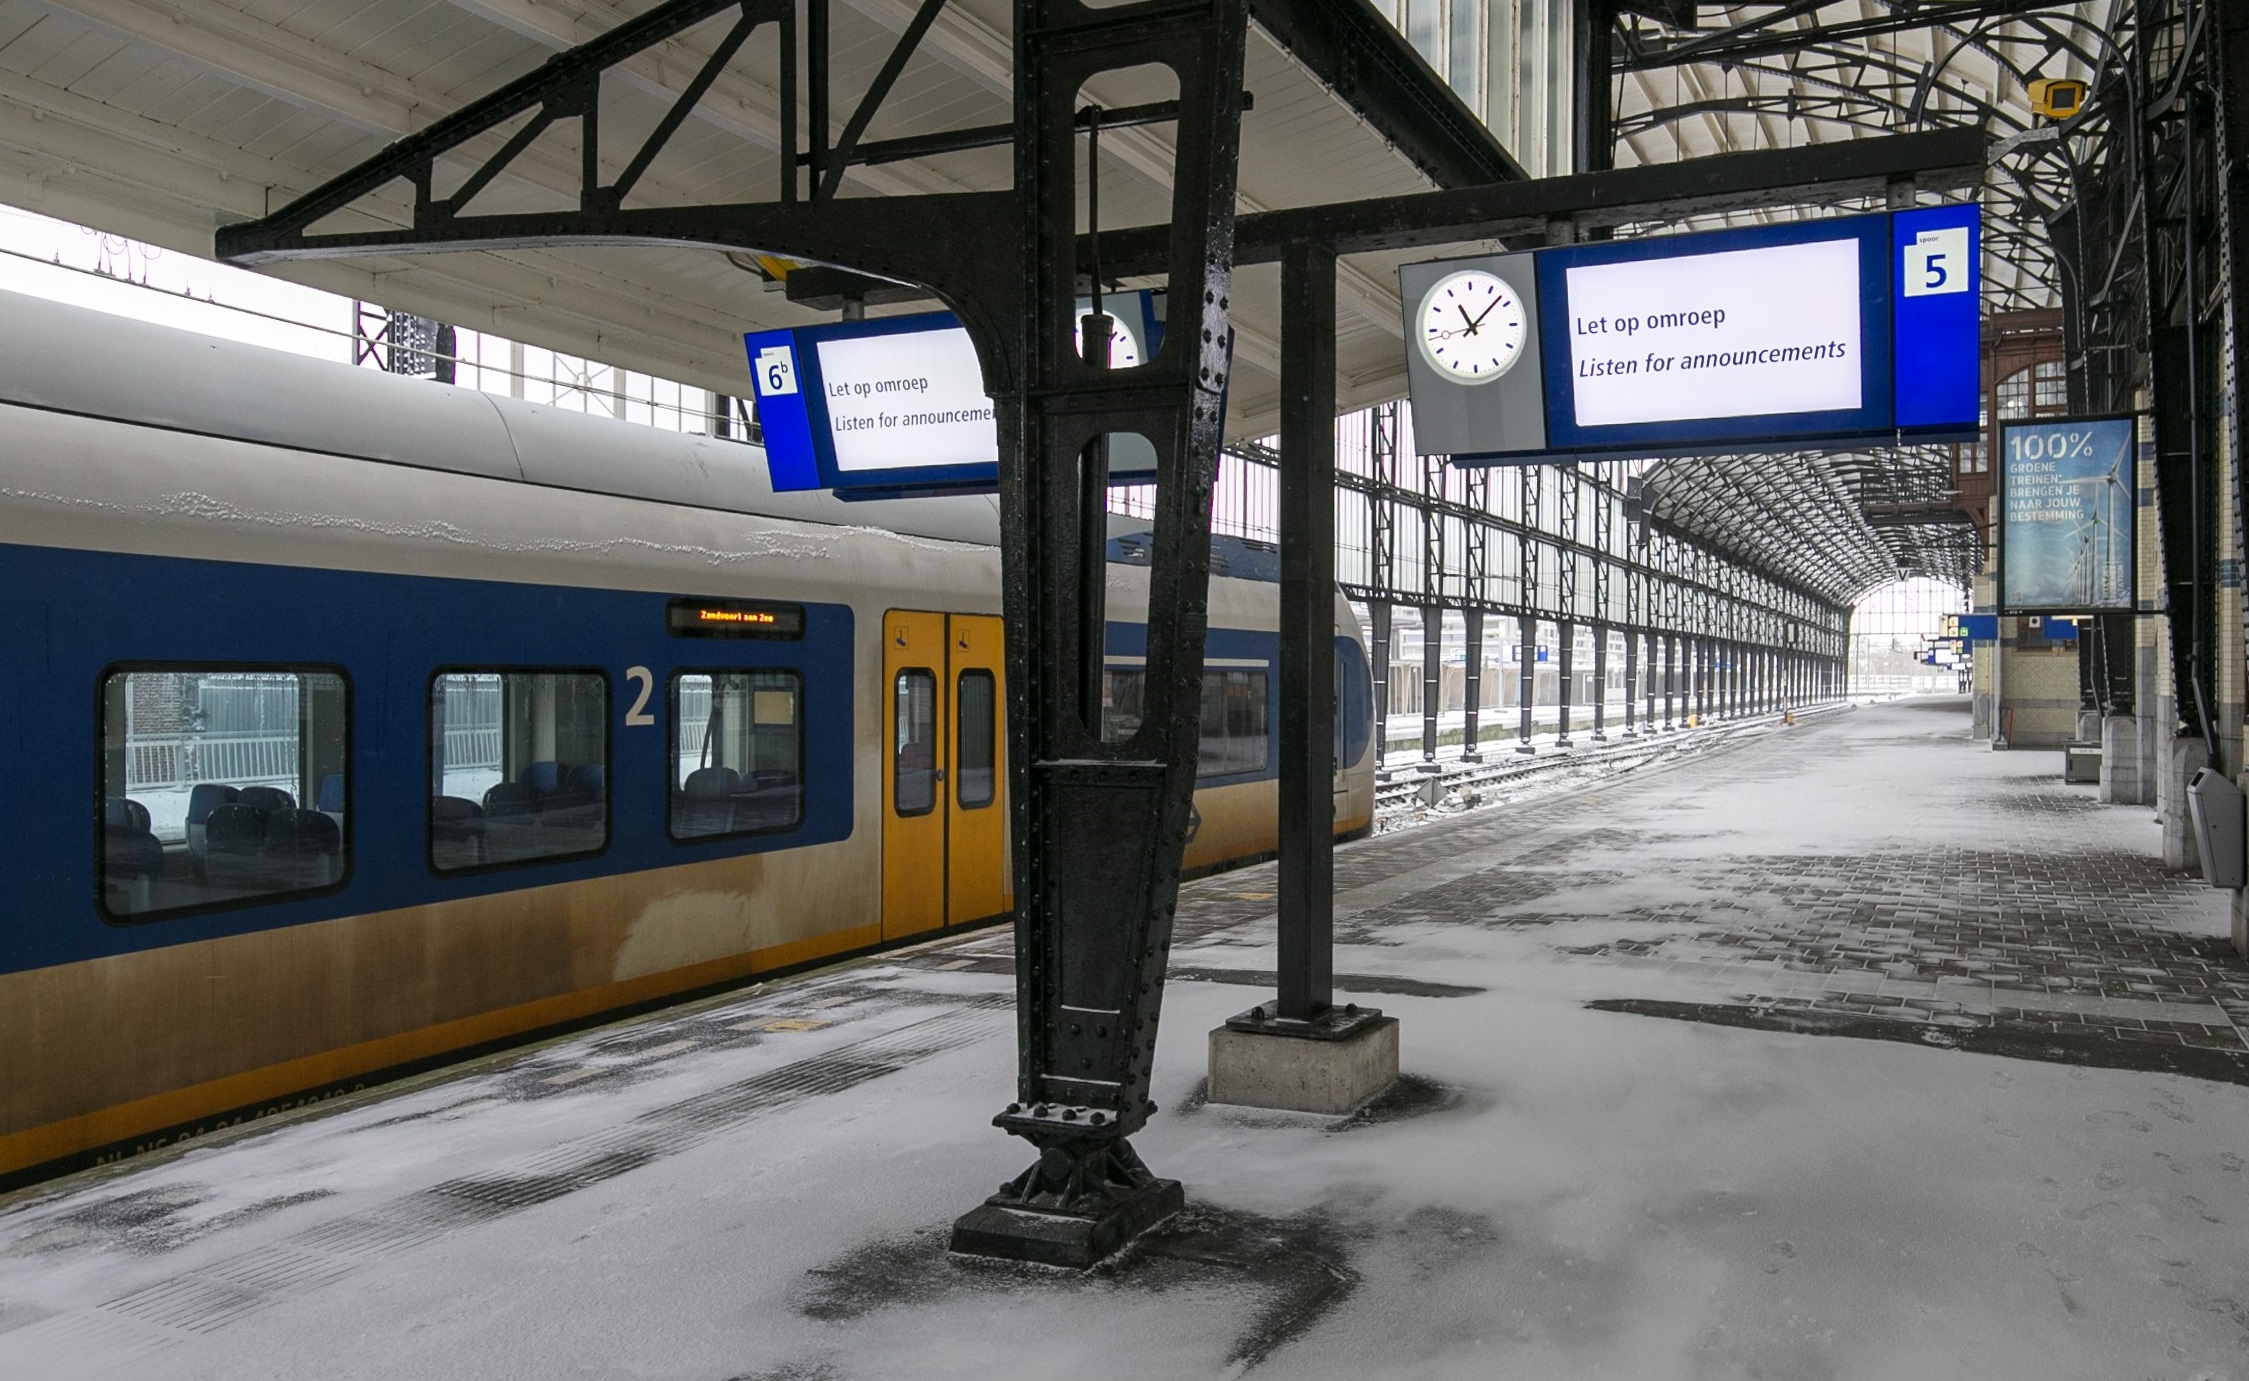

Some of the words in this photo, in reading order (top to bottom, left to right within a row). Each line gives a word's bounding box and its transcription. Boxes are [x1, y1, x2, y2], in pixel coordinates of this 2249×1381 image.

[1919, 236, 1939, 244] spoor
[1926, 254, 1947, 288] 5
[1577, 316, 1608, 335] Let
[1615, 316, 1640, 336] op
[1647, 308, 1726, 329] omroep
[1579, 357, 1638, 377] Listen
[1645, 353, 1675, 373] for
[1680, 340, 1846, 370] announcements
[828, 382, 850, 397] Let
[854, 382, 871, 398] op
[875, 377, 928, 393] omroep
[835, 415, 874, 431] Listen
[879, 411, 898, 428] for
[2010, 431, 2093, 461] 100%
[2010, 462, 2056, 473] GROENE
[2010, 486, 2063, 497] BRENGEN
[2066, 484, 2080, 495] JE
[2010, 499, 2042, 510] NAAR
[2046, 497, 2081, 508] JOUW
[2010, 510, 2084, 522] BESTEMMING
[626, 666, 654, 726] 2
